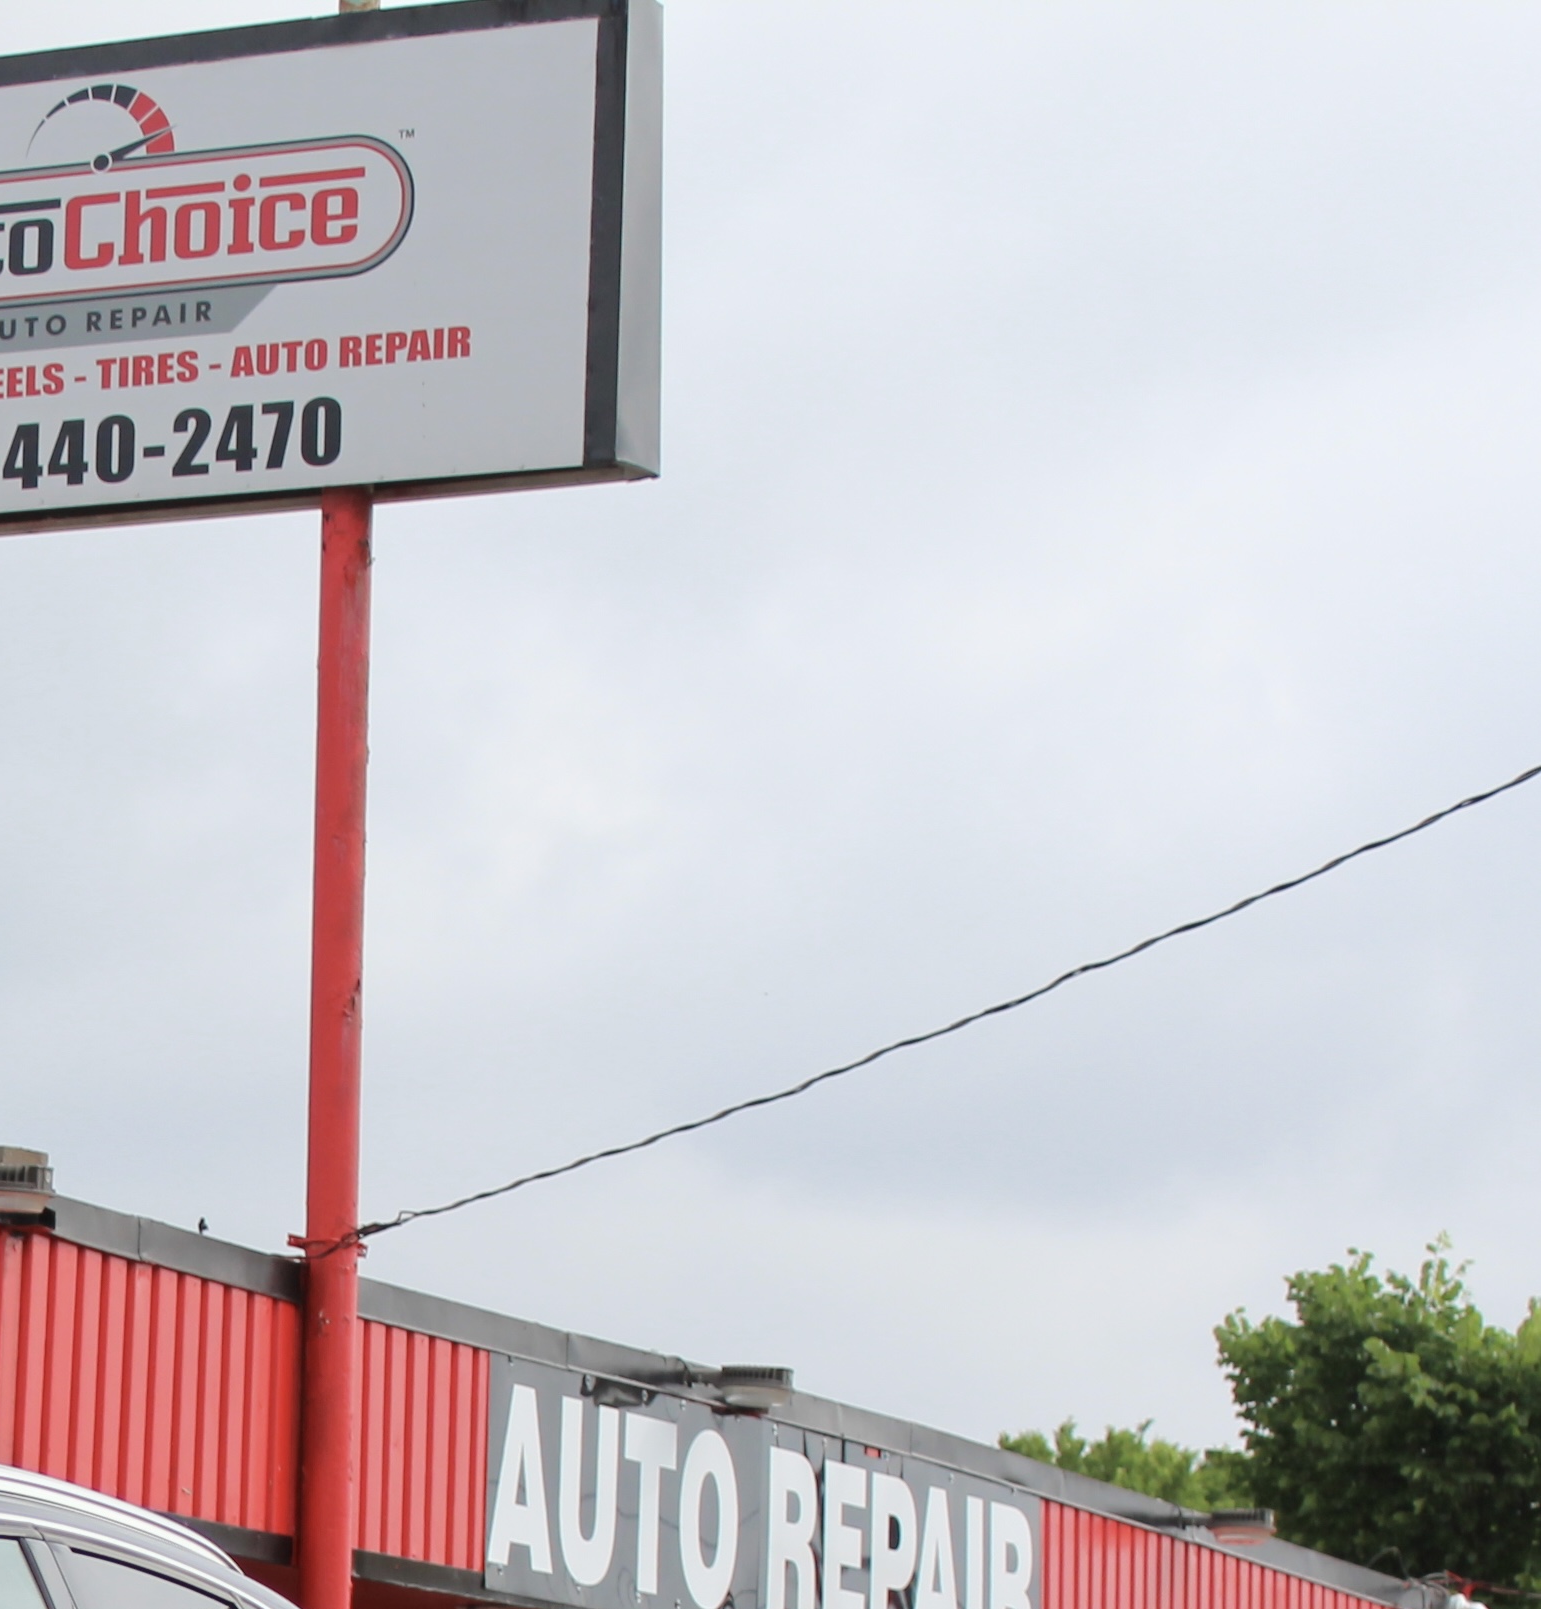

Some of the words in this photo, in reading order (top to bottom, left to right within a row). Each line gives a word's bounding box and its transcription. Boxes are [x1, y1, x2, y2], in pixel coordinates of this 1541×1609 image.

[85, 300, 213, 333] REPAIR
[97, 351, 199, 390] TIRES
[231, 339, 328, 378] AUTO
[339, 326, 471, 368] REPAIR
